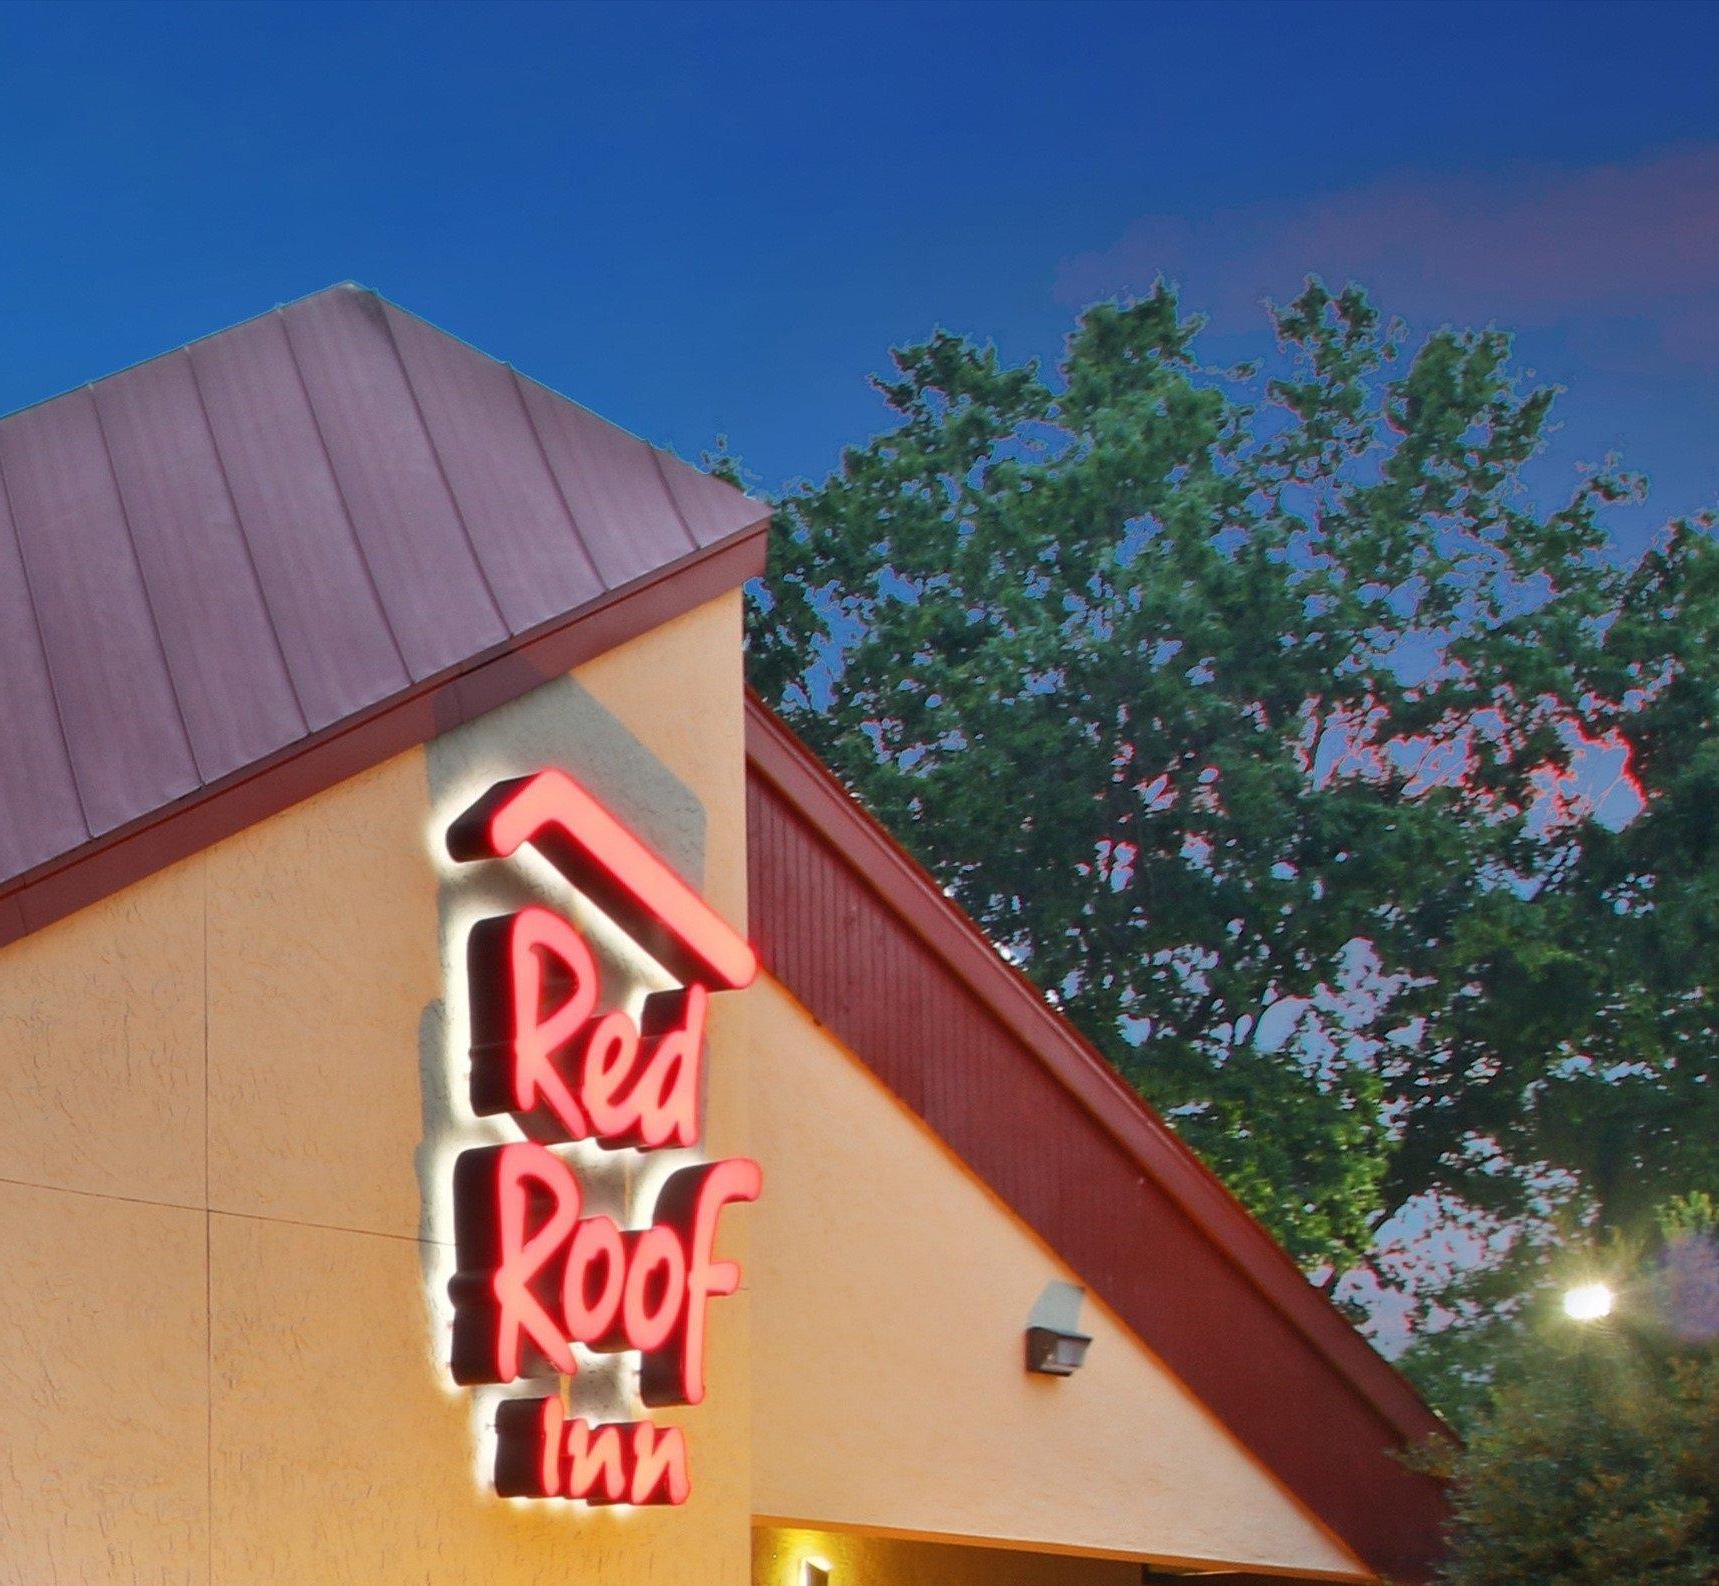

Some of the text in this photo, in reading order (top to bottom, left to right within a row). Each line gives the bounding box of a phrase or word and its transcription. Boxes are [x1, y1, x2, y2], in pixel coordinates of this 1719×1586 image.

[509, 903, 708, 1148] Red
[493, 1141, 763, 1406] Roof
[540, 1394, 691, 1506] Inn
